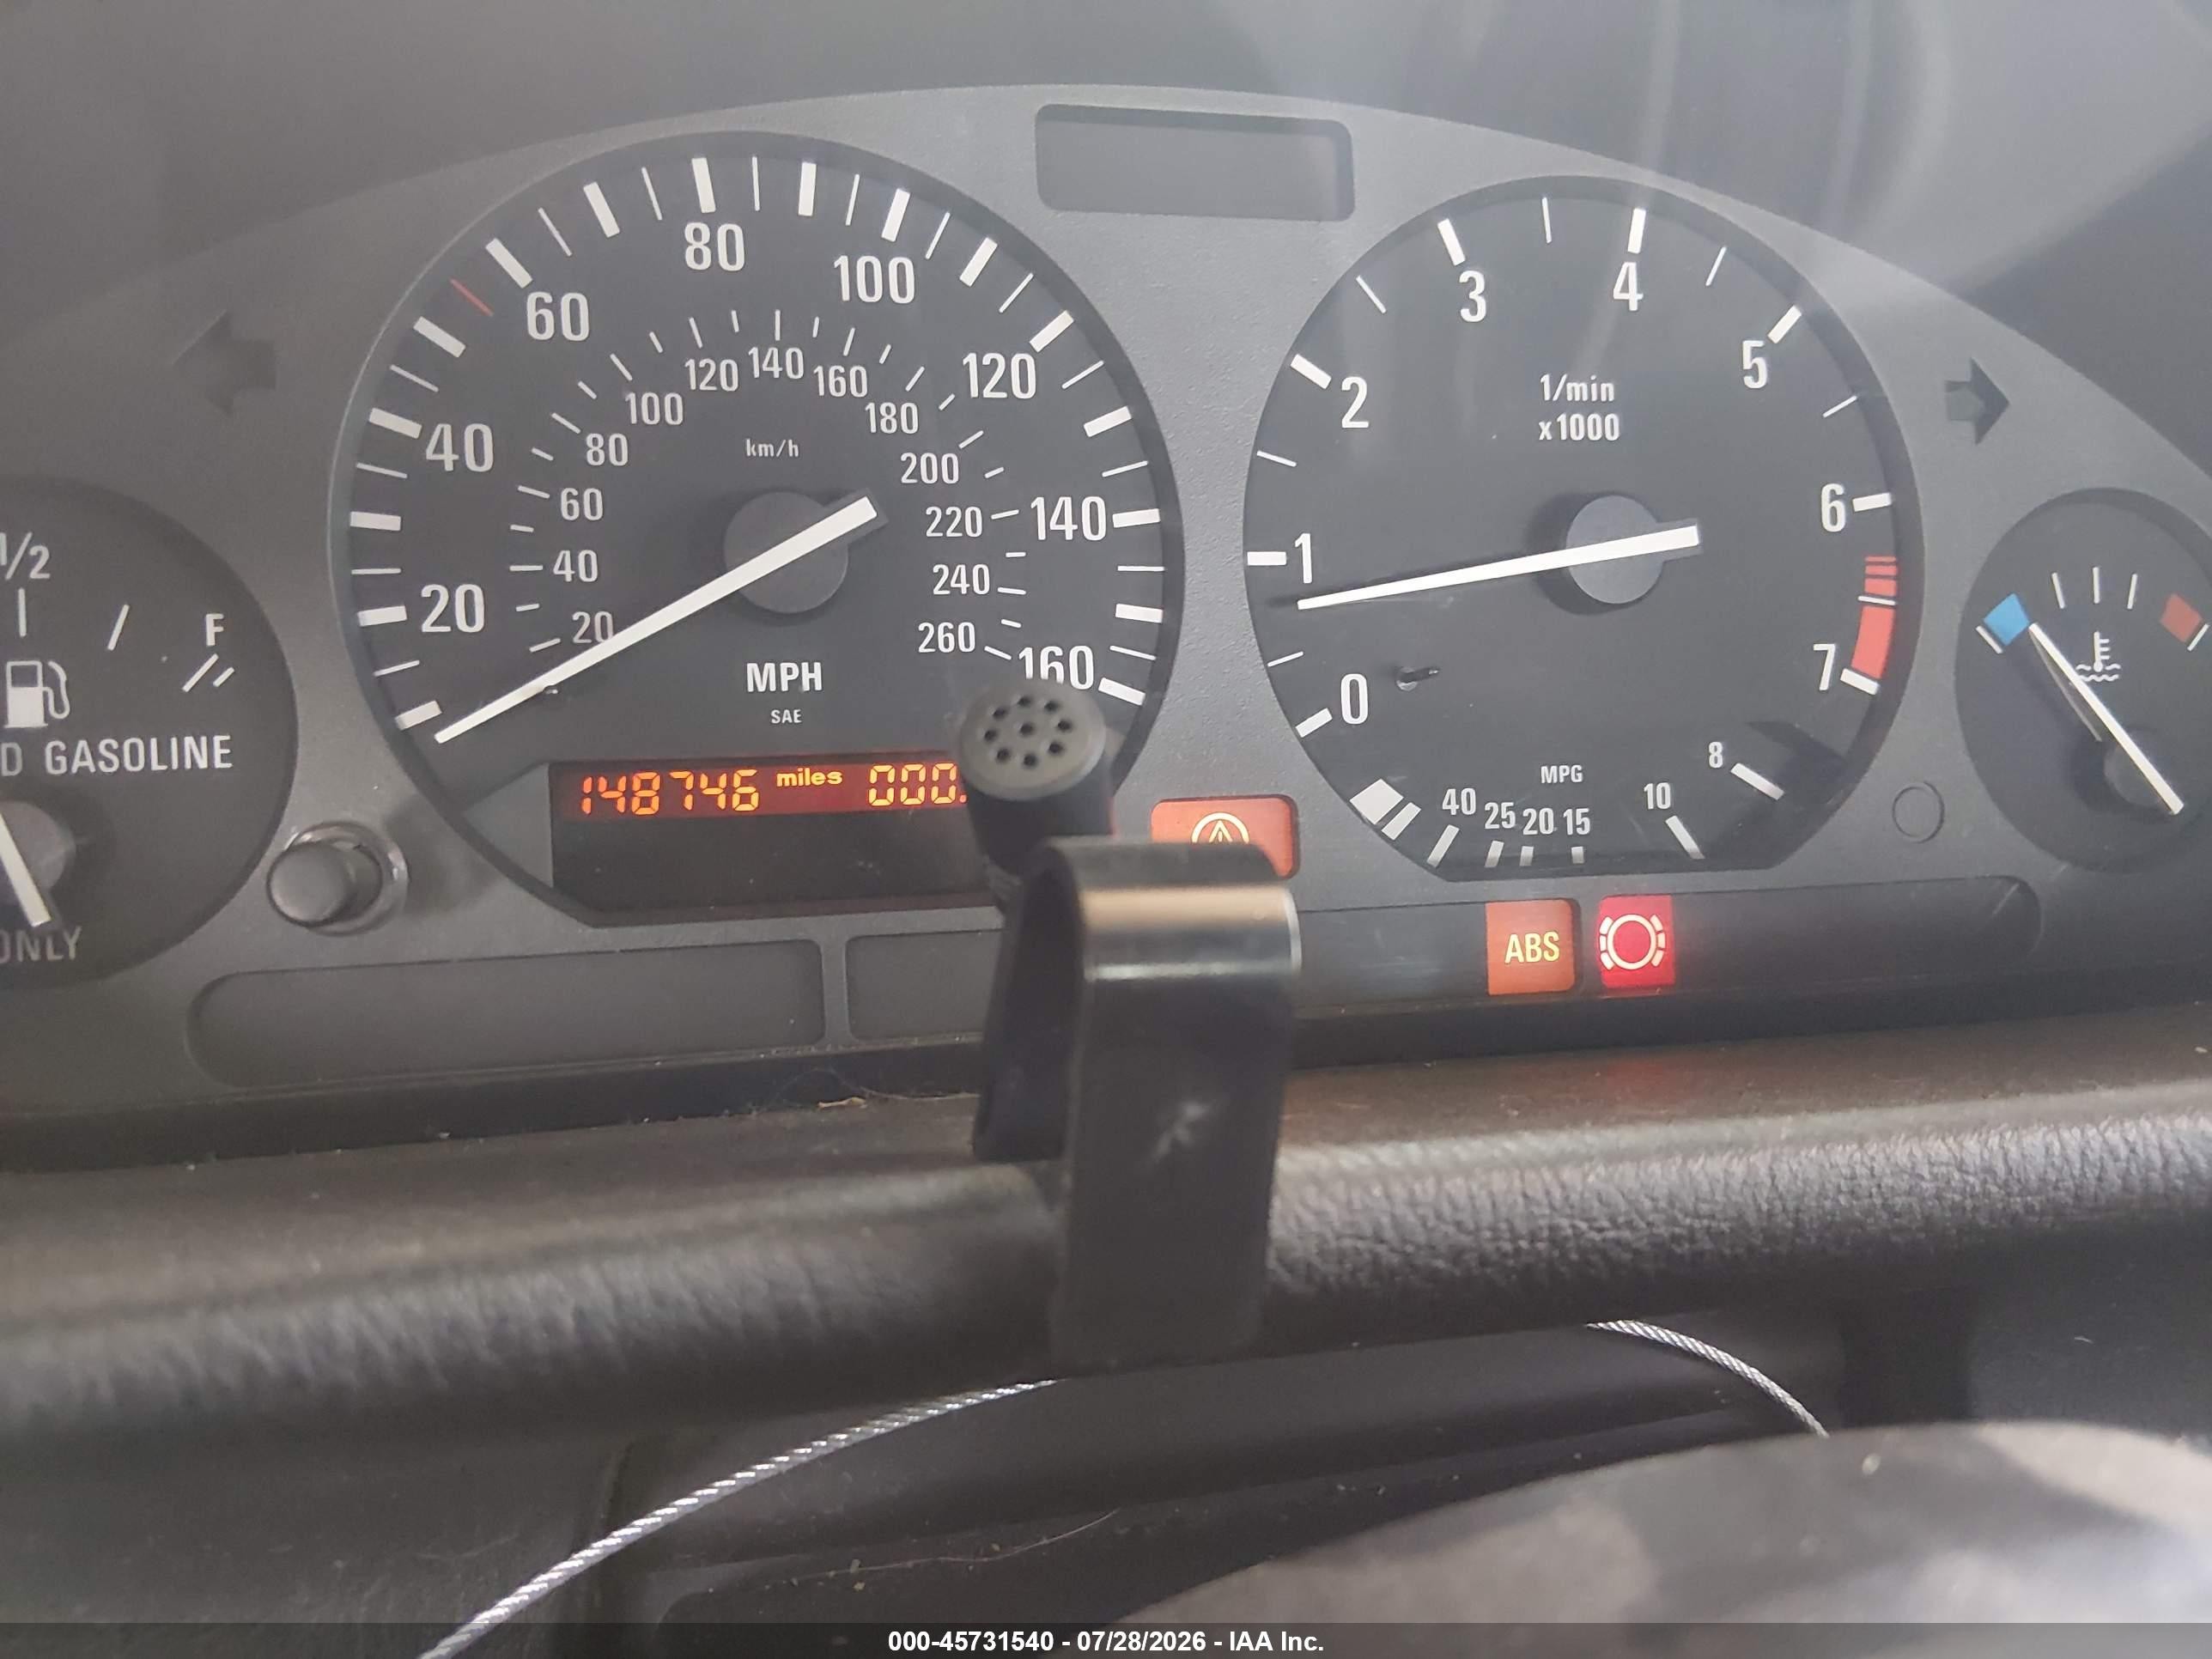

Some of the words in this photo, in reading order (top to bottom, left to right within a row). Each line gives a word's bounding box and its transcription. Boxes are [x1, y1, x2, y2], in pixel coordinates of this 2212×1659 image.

[684, 222, 745, 271] 80
[834, 255, 915, 304] 100
[1459, 270, 1486, 322] 3
[1613, 261, 1644, 311] 4
[526, 291, 590, 342] 60
[684, 358, 738, 392] 120
[748, 346, 805, 380] 140
[963, 352, 1036, 399] 120
[1742, 339, 1768, 389] 5
[813, 365, 868, 398] 160
[1540, 374, 1614, 402] 1/min
[625, 392, 684, 425] 100
[865, 402, 919, 434] 180
[1341, 376, 1370, 428] 2
[425, 422, 494, 472] 40
[586, 433, 629, 466] 80
[746, 438, 799, 458] km/h
[900, 452, 959, 484] 200
[560, 487, 604, 521] 60
[1030, 495, 1107, 541] 140
[1820, 483, 1846, 532] 6
[926, 506, 982, 538] 220
[552, 549, 599, 582] 40
[1294, 532, 1313, 584] 1
[933, 563, 990, 595] 240
[421, 583, 485, 633] 20
[205, 613, 224, 647] F
[572, 611, 614, 643] 20
[918, 622, 975, 653] 260
[746, 661, 823, 692] MPH
[1018, 645, 1094, 690] 160
[1813, 643, 1837, 691] 7
[1340, 673, 1369, 725] 0
[770, 708, 802, 724] SAE
[45, 735, 233, 775] GASOLINE
[1708, 741, 1723, 769] 8
[1540, 764, 1583, 784] MPG
[581, 769, 759, 816] 148746
[776, 767, 843, 787] miles
[1442, 787, 1476, 816] 40
[1644, 781, 1671, 810] 10
[1484, 801, 1516, 830] 25
[1522, 807, 1554, 836] 20
[1563, 807, 1590, 836] 15
[1504, 931, 1559, 963] ABS
